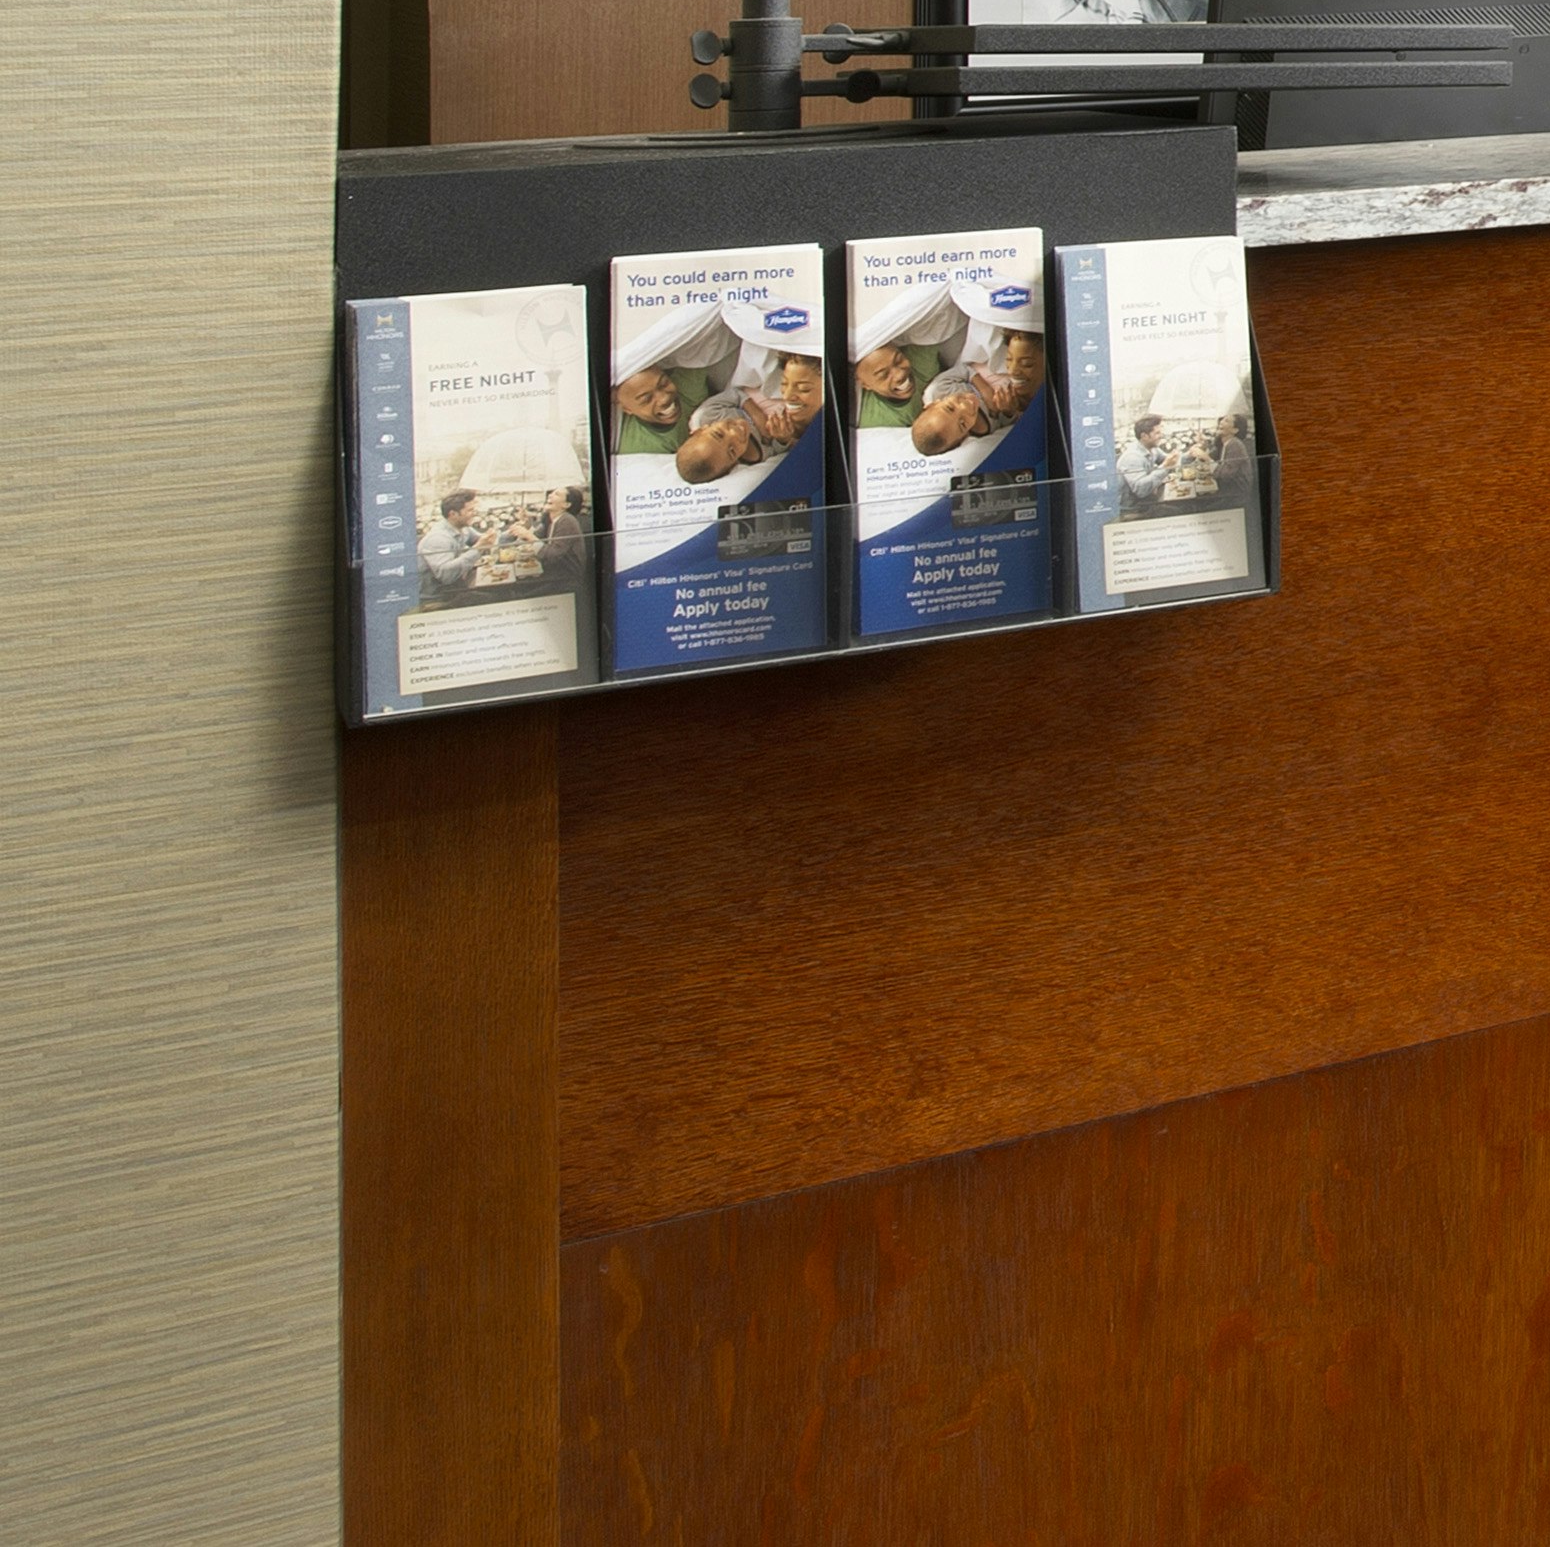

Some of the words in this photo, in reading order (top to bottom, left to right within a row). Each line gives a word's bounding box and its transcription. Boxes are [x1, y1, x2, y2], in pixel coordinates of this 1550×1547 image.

[864, 256, 891, 268] You
[896, 252, 936, 266] could
[941, 251, 974, 263] earn
[980, 247, 1016, 259] more
[628, 274, 657, 287] You
[663, 270, 706, 285] could
[712, 269, 748, 282] earn
[754, 266, 795, 280] more
[864, 275, 898, 288] than
[904, 275, 912, 285] a
[955, 267, 993, 283] night
[627, 294, 665, 307] than
[671, 295, 680, 305] a
[727, 286, 768, 303] night
[1122, 315, 1158, 329] FREE
[1162, 311, 1207, 326] NIGHT
[428, 361, 468, 372] EARNING
[429, 376, 473, 393] FREE
[480, 370, 536, 387] NIGHT
[429, 398, 459, 408] NEVER
[462, 396, 482, 405] FELT
[484, 394, 497, 403] SO
[867, 467, 884, 475] Earn
[887, 459, 926, 472] 15,000
[906, 470, 928, 478] bonus
[931, 468, 954, 476] points
[648, 487, 692, 500] 15,000
[669, 498, 693, 507] bonus
[697, 496, 722, 505] points
[891, 543, 916, 553] Hilton
[980, 531, 1018, 544] Signature
[1020, 528, 1040, 538] Card
[914, 556, 931, 567] No
[935, 549, 975, 565] annual
[979, 547, 998, 559] fee
[650, 576, 677, 586] Hilton
[748, 563, 790, 576] Signature
[792, 561, 814, 571] Card
[912, 567, 954, 584] Apply
[959, 562, 1000, 577] today
[676, 588, 695, 600] No
[698, 582, 743, 597] annual
[747, 580, 767, 592] fee
[673, 601, 720, 619] Apply
[724, 595, 770, 611] today
